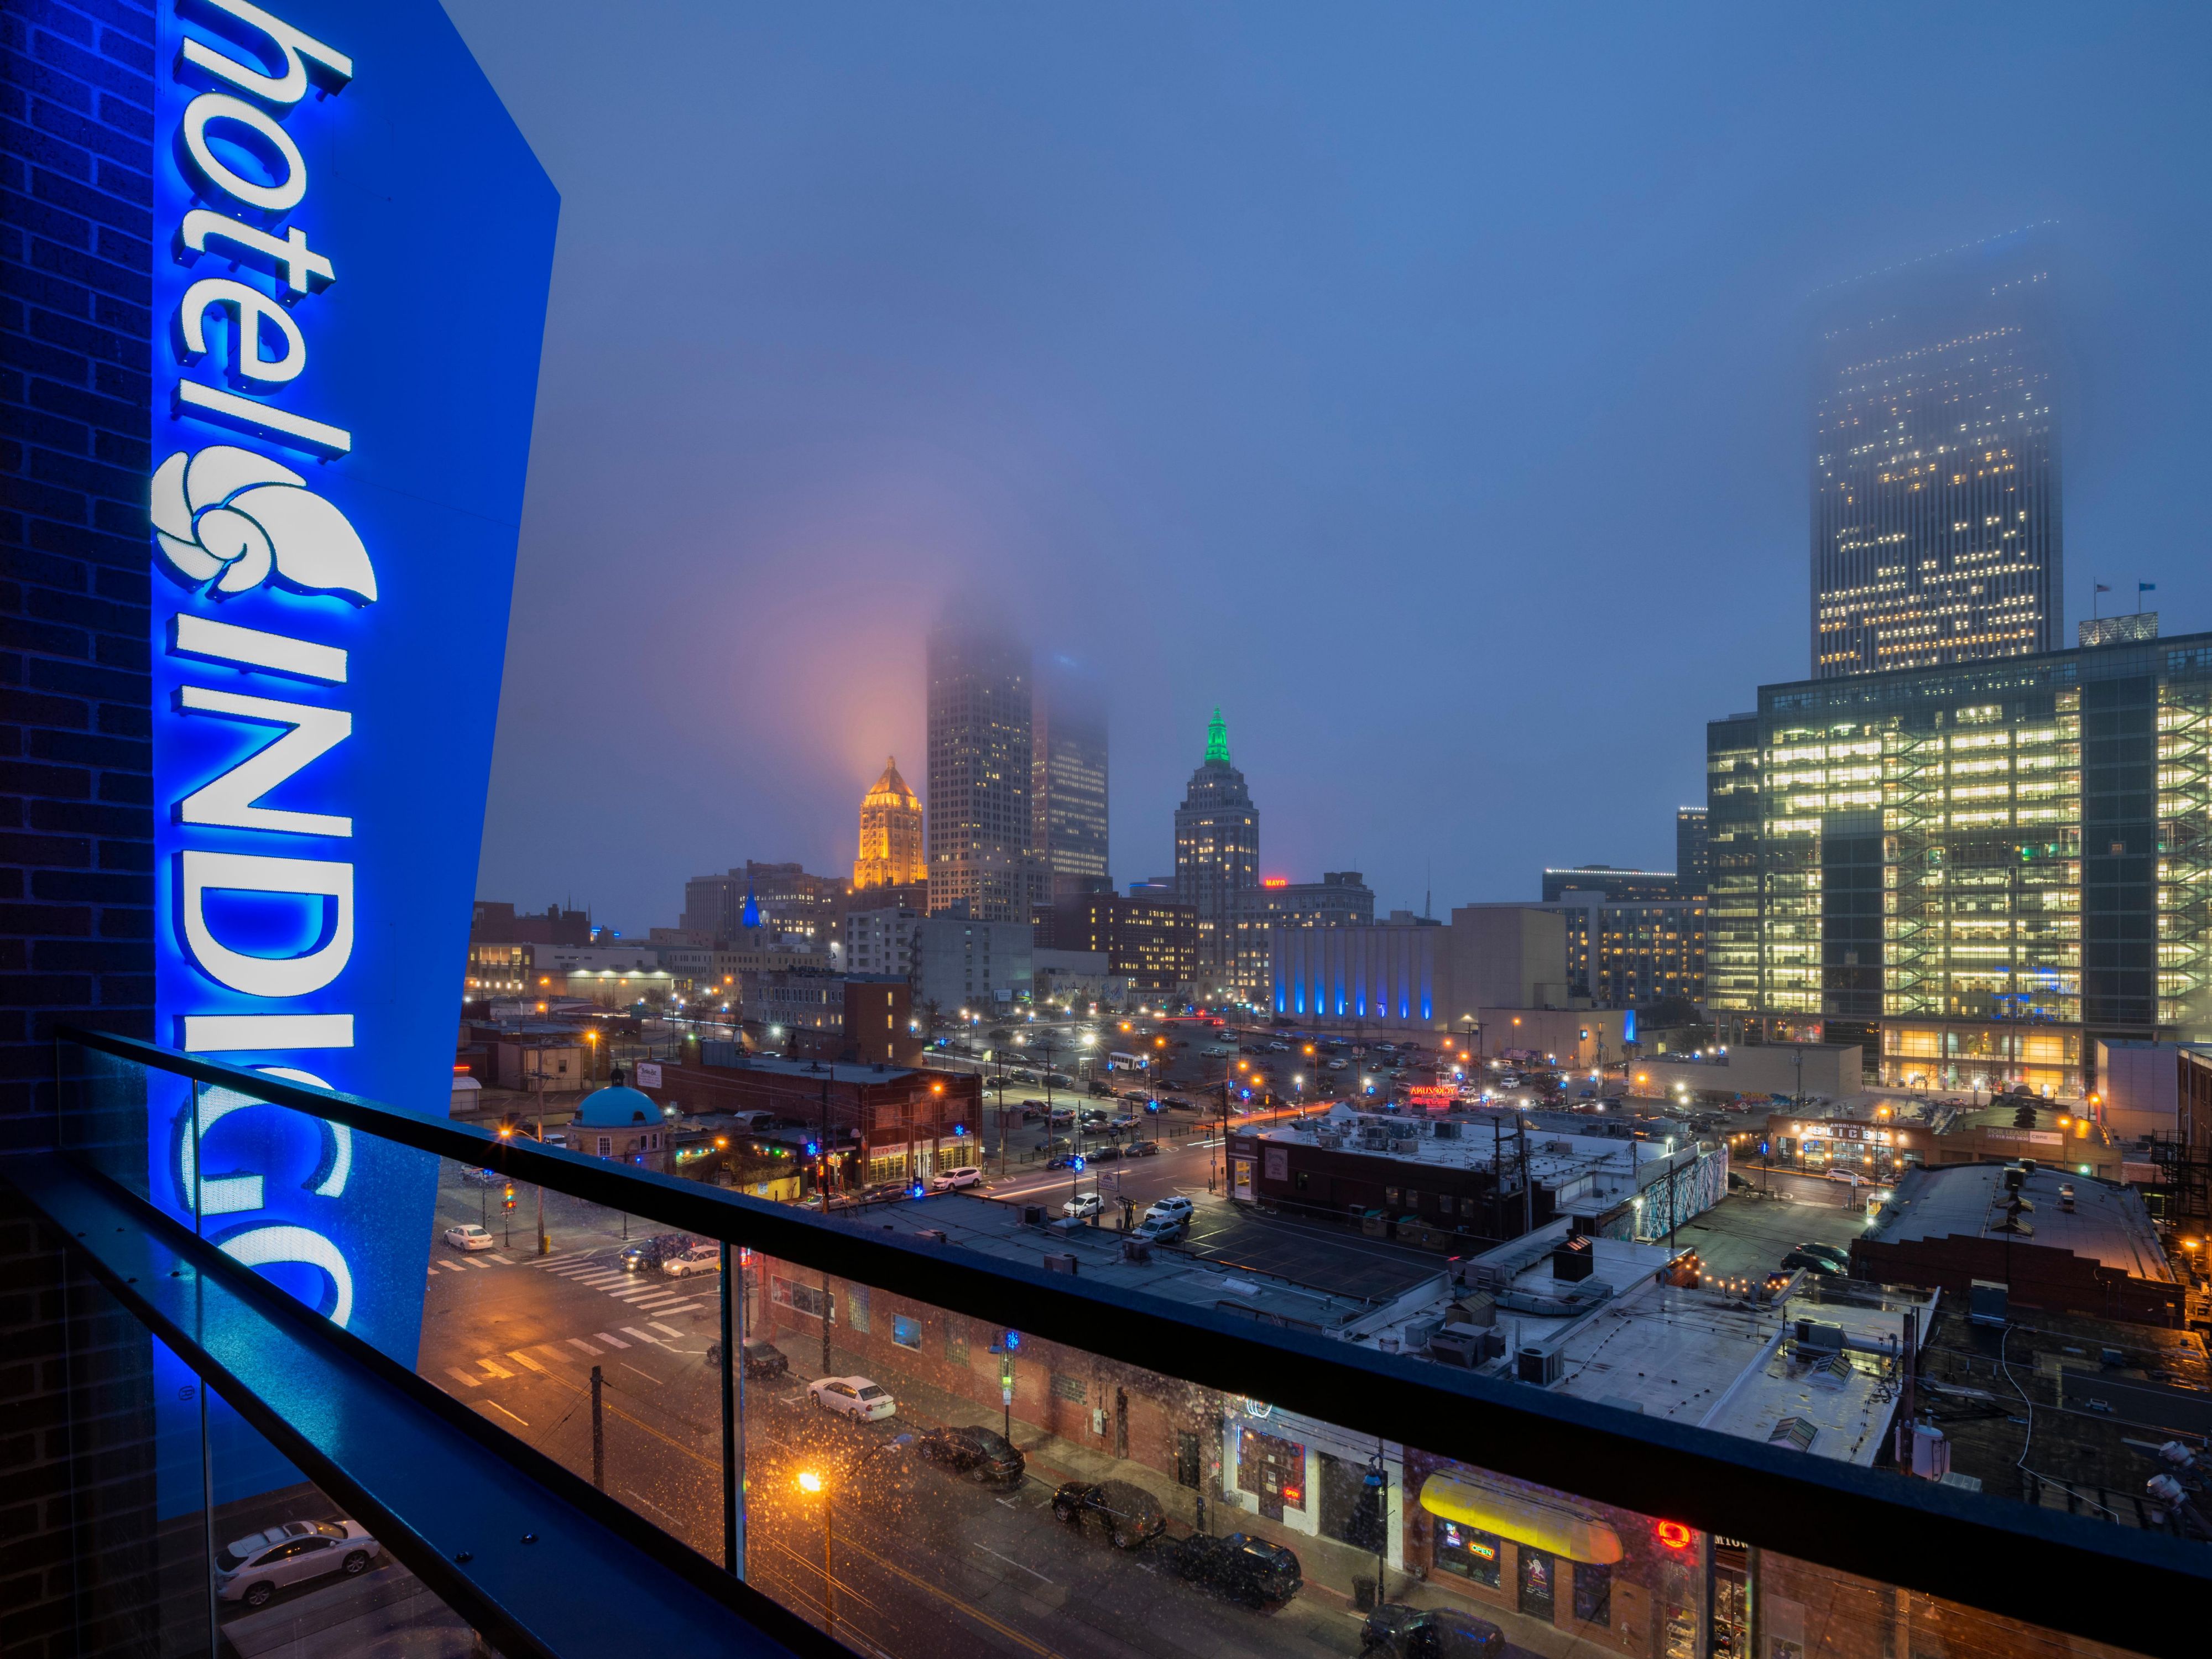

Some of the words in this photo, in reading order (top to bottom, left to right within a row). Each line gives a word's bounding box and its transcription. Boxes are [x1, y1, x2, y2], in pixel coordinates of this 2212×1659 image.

[178, 0, 354, 460] hotel
[1286, 1489, 1298, 1498] OPEN
[1472, 1545, 1491, 1556] OPEN
